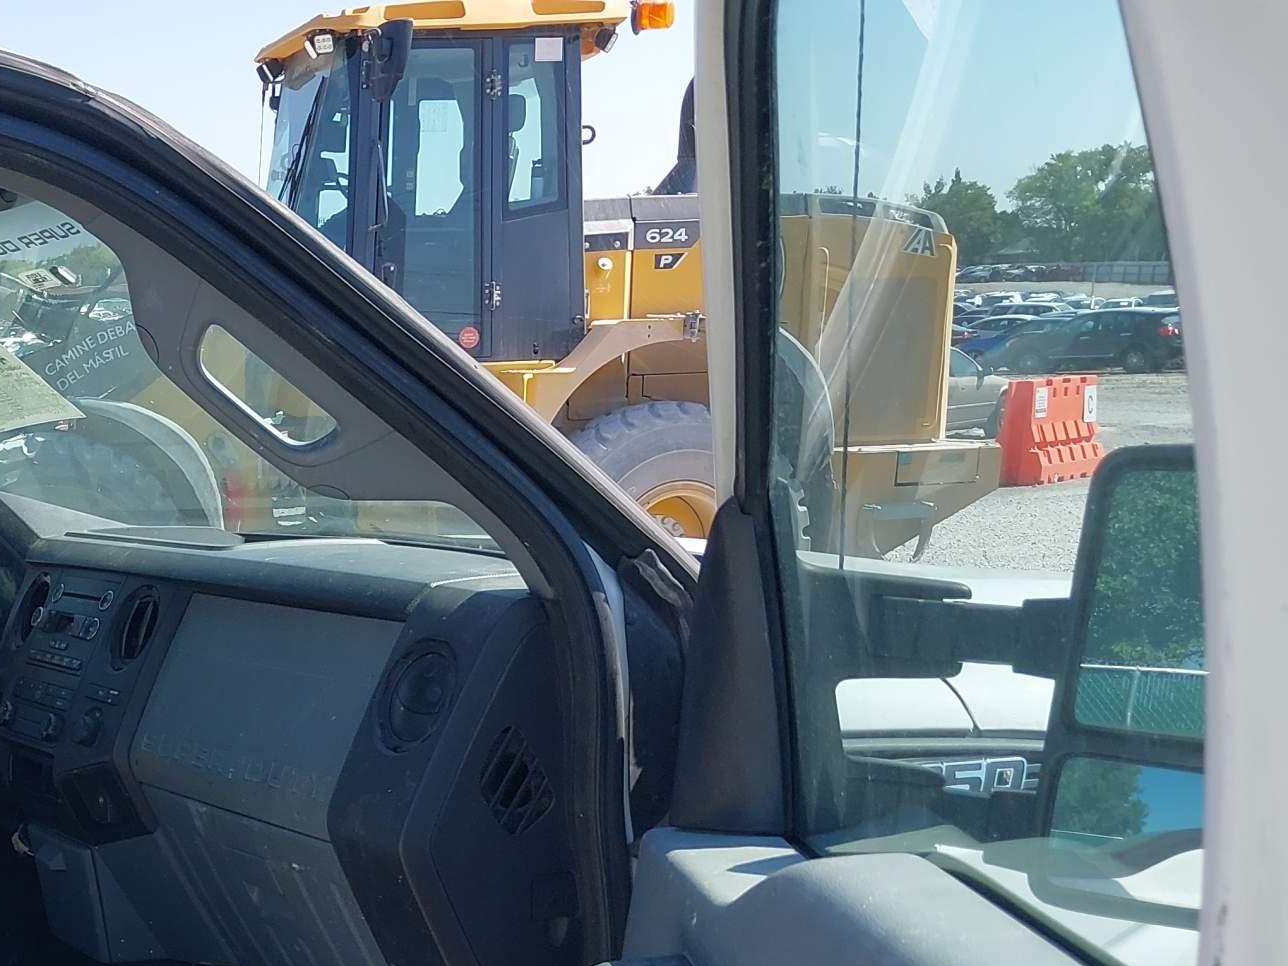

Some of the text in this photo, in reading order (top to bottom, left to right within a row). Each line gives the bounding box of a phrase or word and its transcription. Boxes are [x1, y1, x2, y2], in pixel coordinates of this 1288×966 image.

[646, 228, 688, 243] 624
[659, 255, 673, 268] P
[45, 335, 97, 375] CAMINE
[56, 369, 85, 391] DEL
